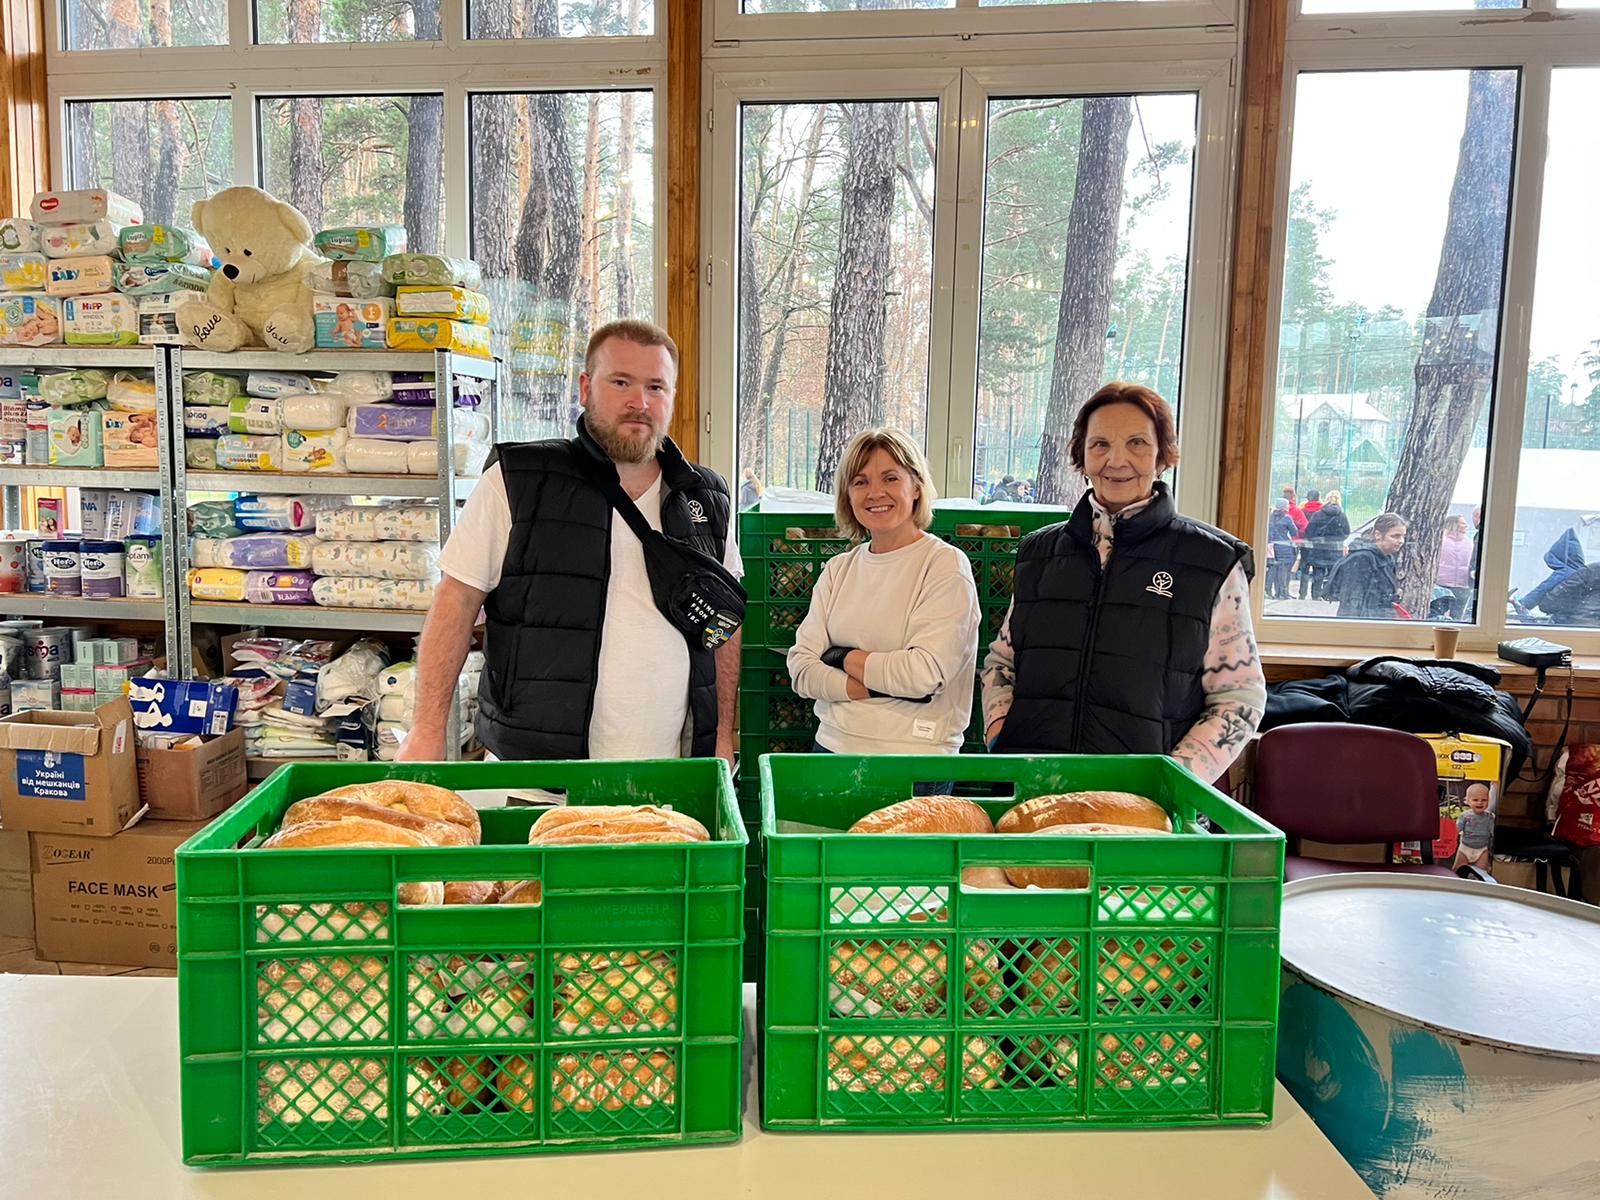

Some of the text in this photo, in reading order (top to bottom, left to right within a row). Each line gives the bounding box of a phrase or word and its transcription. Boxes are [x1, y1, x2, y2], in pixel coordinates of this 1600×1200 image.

[52, 270, 79, 281] BABY
[193, 314, 221, 343] Love
[265, 322, 289, 346] You
[690, 602, 709, 620] FROM
[692, 592, 715, 615] VIKING
[21, 777, 81, 789] від мешканців
[35, 769, 65, 779] Україні
[34, 787, 68, 797] Кракова
[68, 880, 159, 899] FACE MASK
